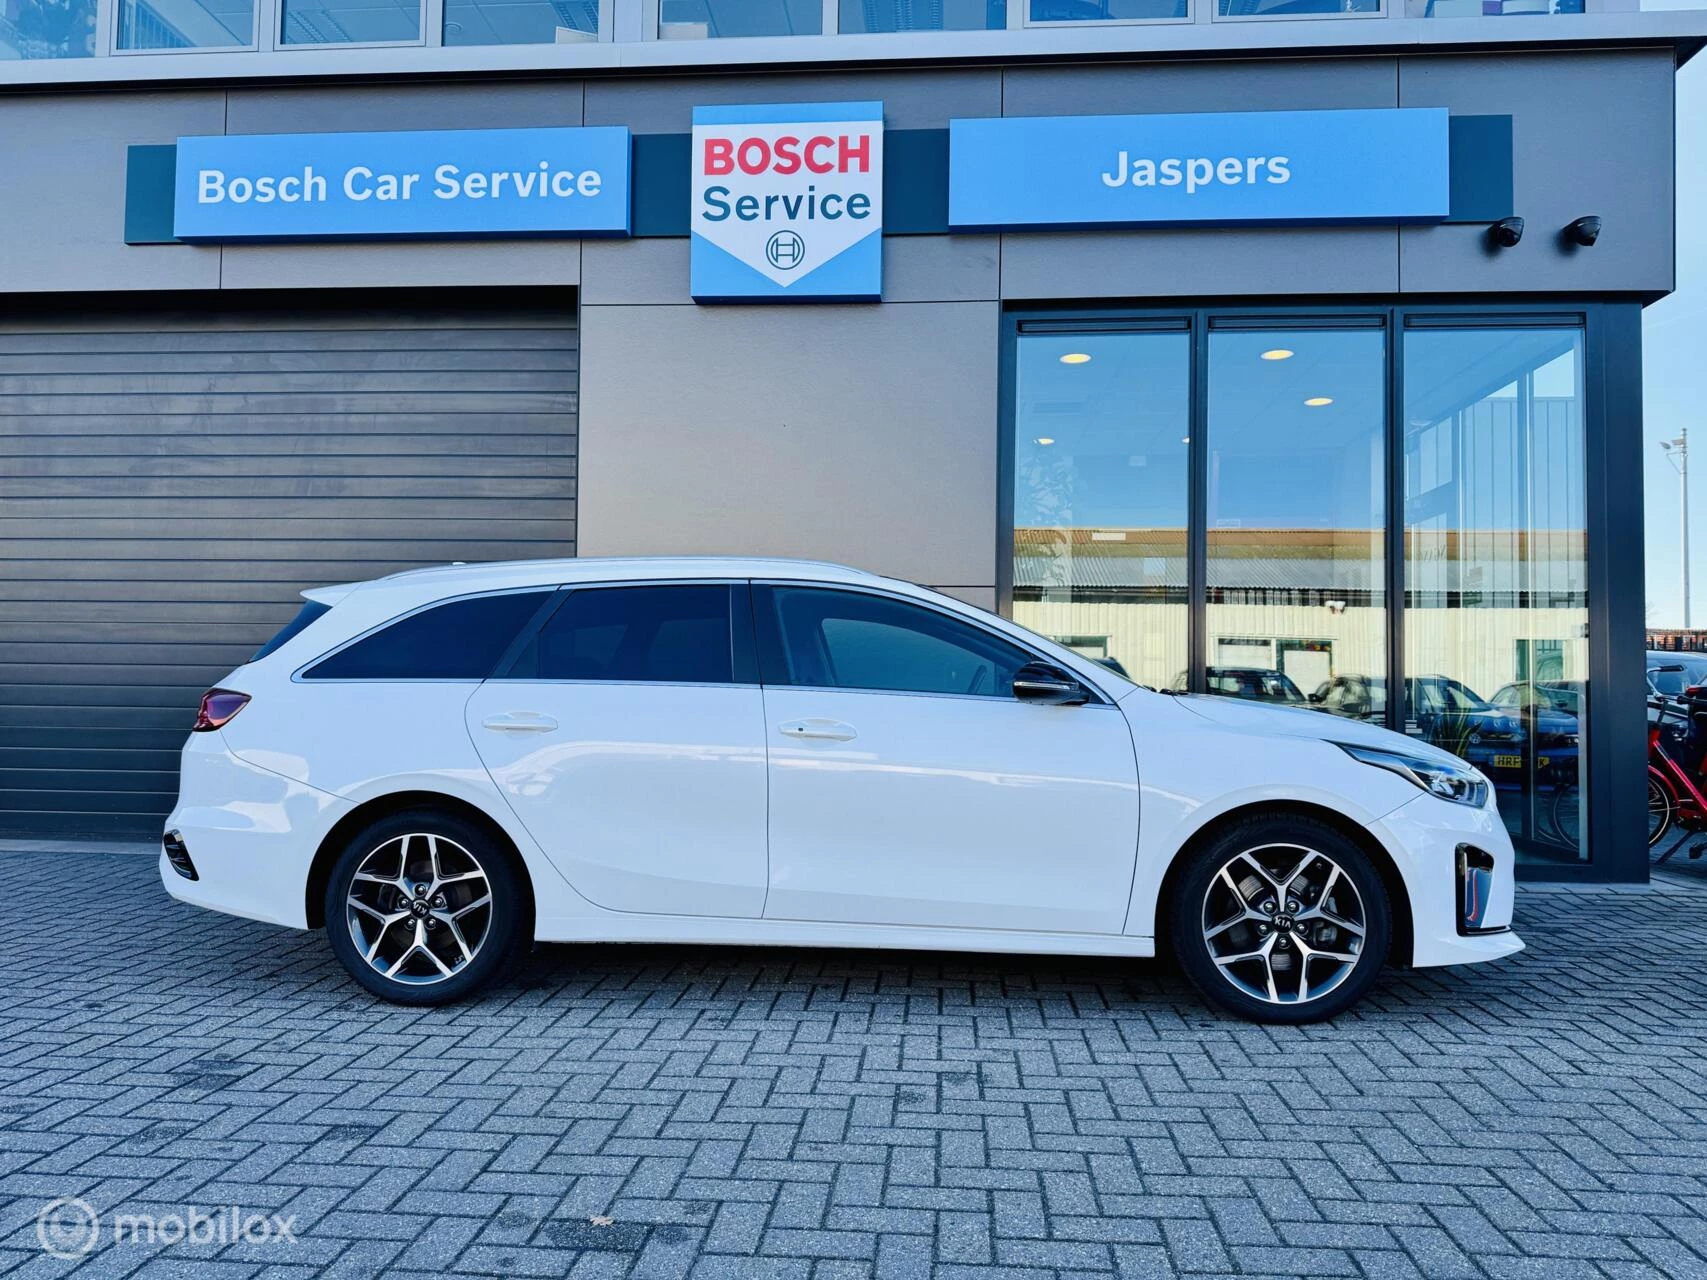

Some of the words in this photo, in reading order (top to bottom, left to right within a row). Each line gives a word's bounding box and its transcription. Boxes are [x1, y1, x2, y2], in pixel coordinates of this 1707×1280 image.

[704, 135, 870, 176] BOSCH
[1102, 151, 1291, 194] Jaspers
[198, 166, 326, 204] Bosch
[343, 166, 419, 201] Car
[433, 160, 601, 199] Service
[702, 185, 871, 221] Service
[412, 902, 427, 915] KIA
[1274, 917, 1291, 929] KIA
